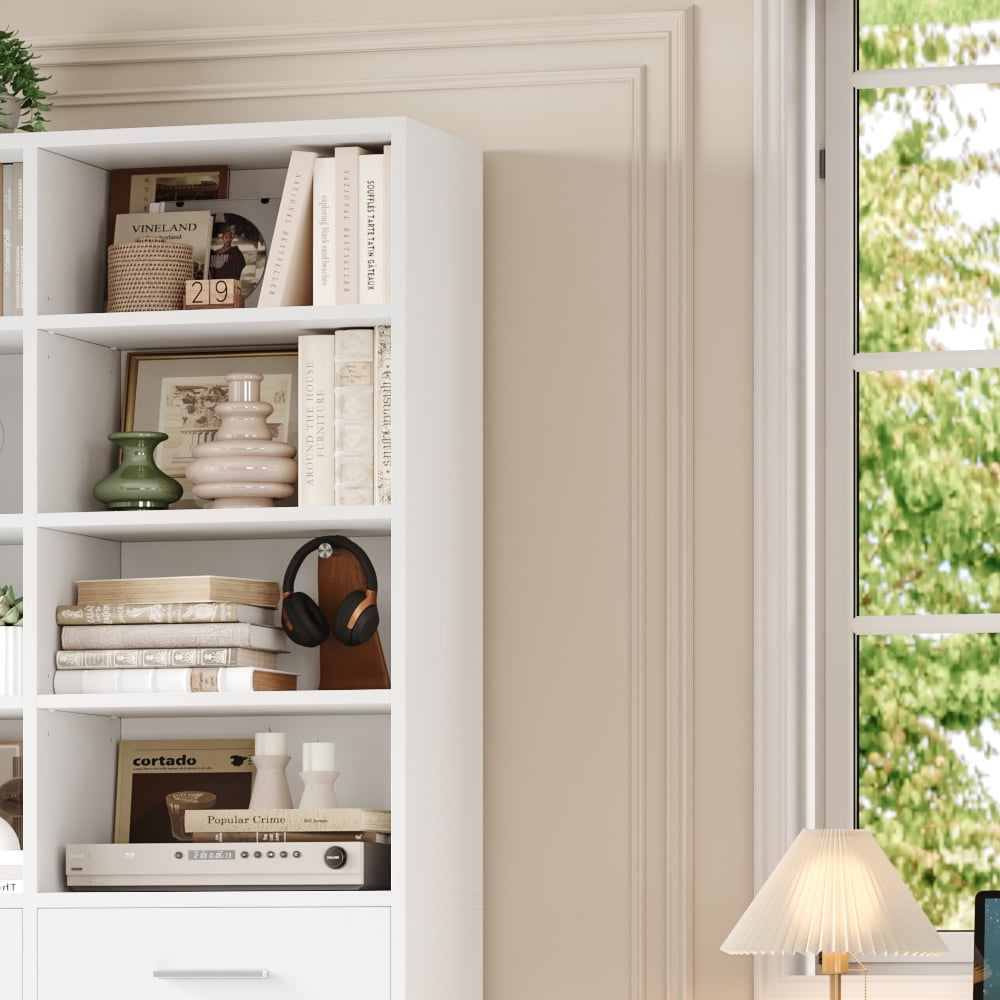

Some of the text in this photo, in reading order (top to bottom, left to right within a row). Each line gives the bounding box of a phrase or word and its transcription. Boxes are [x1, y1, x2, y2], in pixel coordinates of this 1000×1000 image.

[132, 223, 198, 233] VINELAND
[305, 360, 314, 485] AROUND THE HOUSE
[316, 389, 325, 457] FURNITURE
[132, 754, 197, 767] cortado
[207, 815, 250, 826] Popular
[252, 815, 286, 825] Crime
